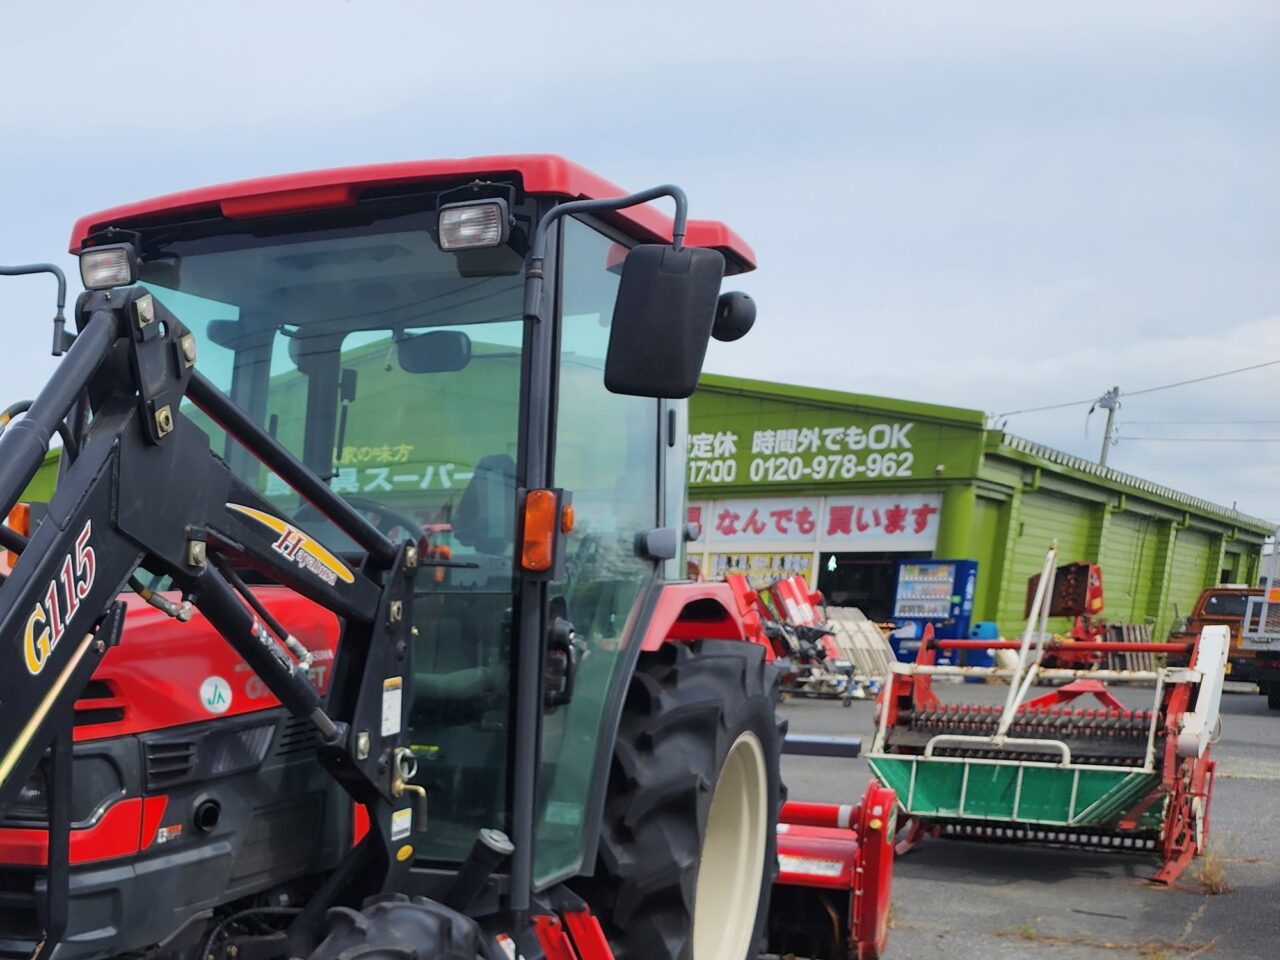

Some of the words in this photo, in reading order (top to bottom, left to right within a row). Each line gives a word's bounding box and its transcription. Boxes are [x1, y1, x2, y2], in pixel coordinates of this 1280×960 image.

[332, 443, 414, 465] 家の味方
[687, 431, 738, 458] 定休
[751, 422, 914, 455] 時間外でもOK
[750, 451, 914, 482] 0120-978-962
[716, 507, 816, 536] なんでも
[826, 504, 938, 537] 買います
[24, 519, 96, 676] G115
